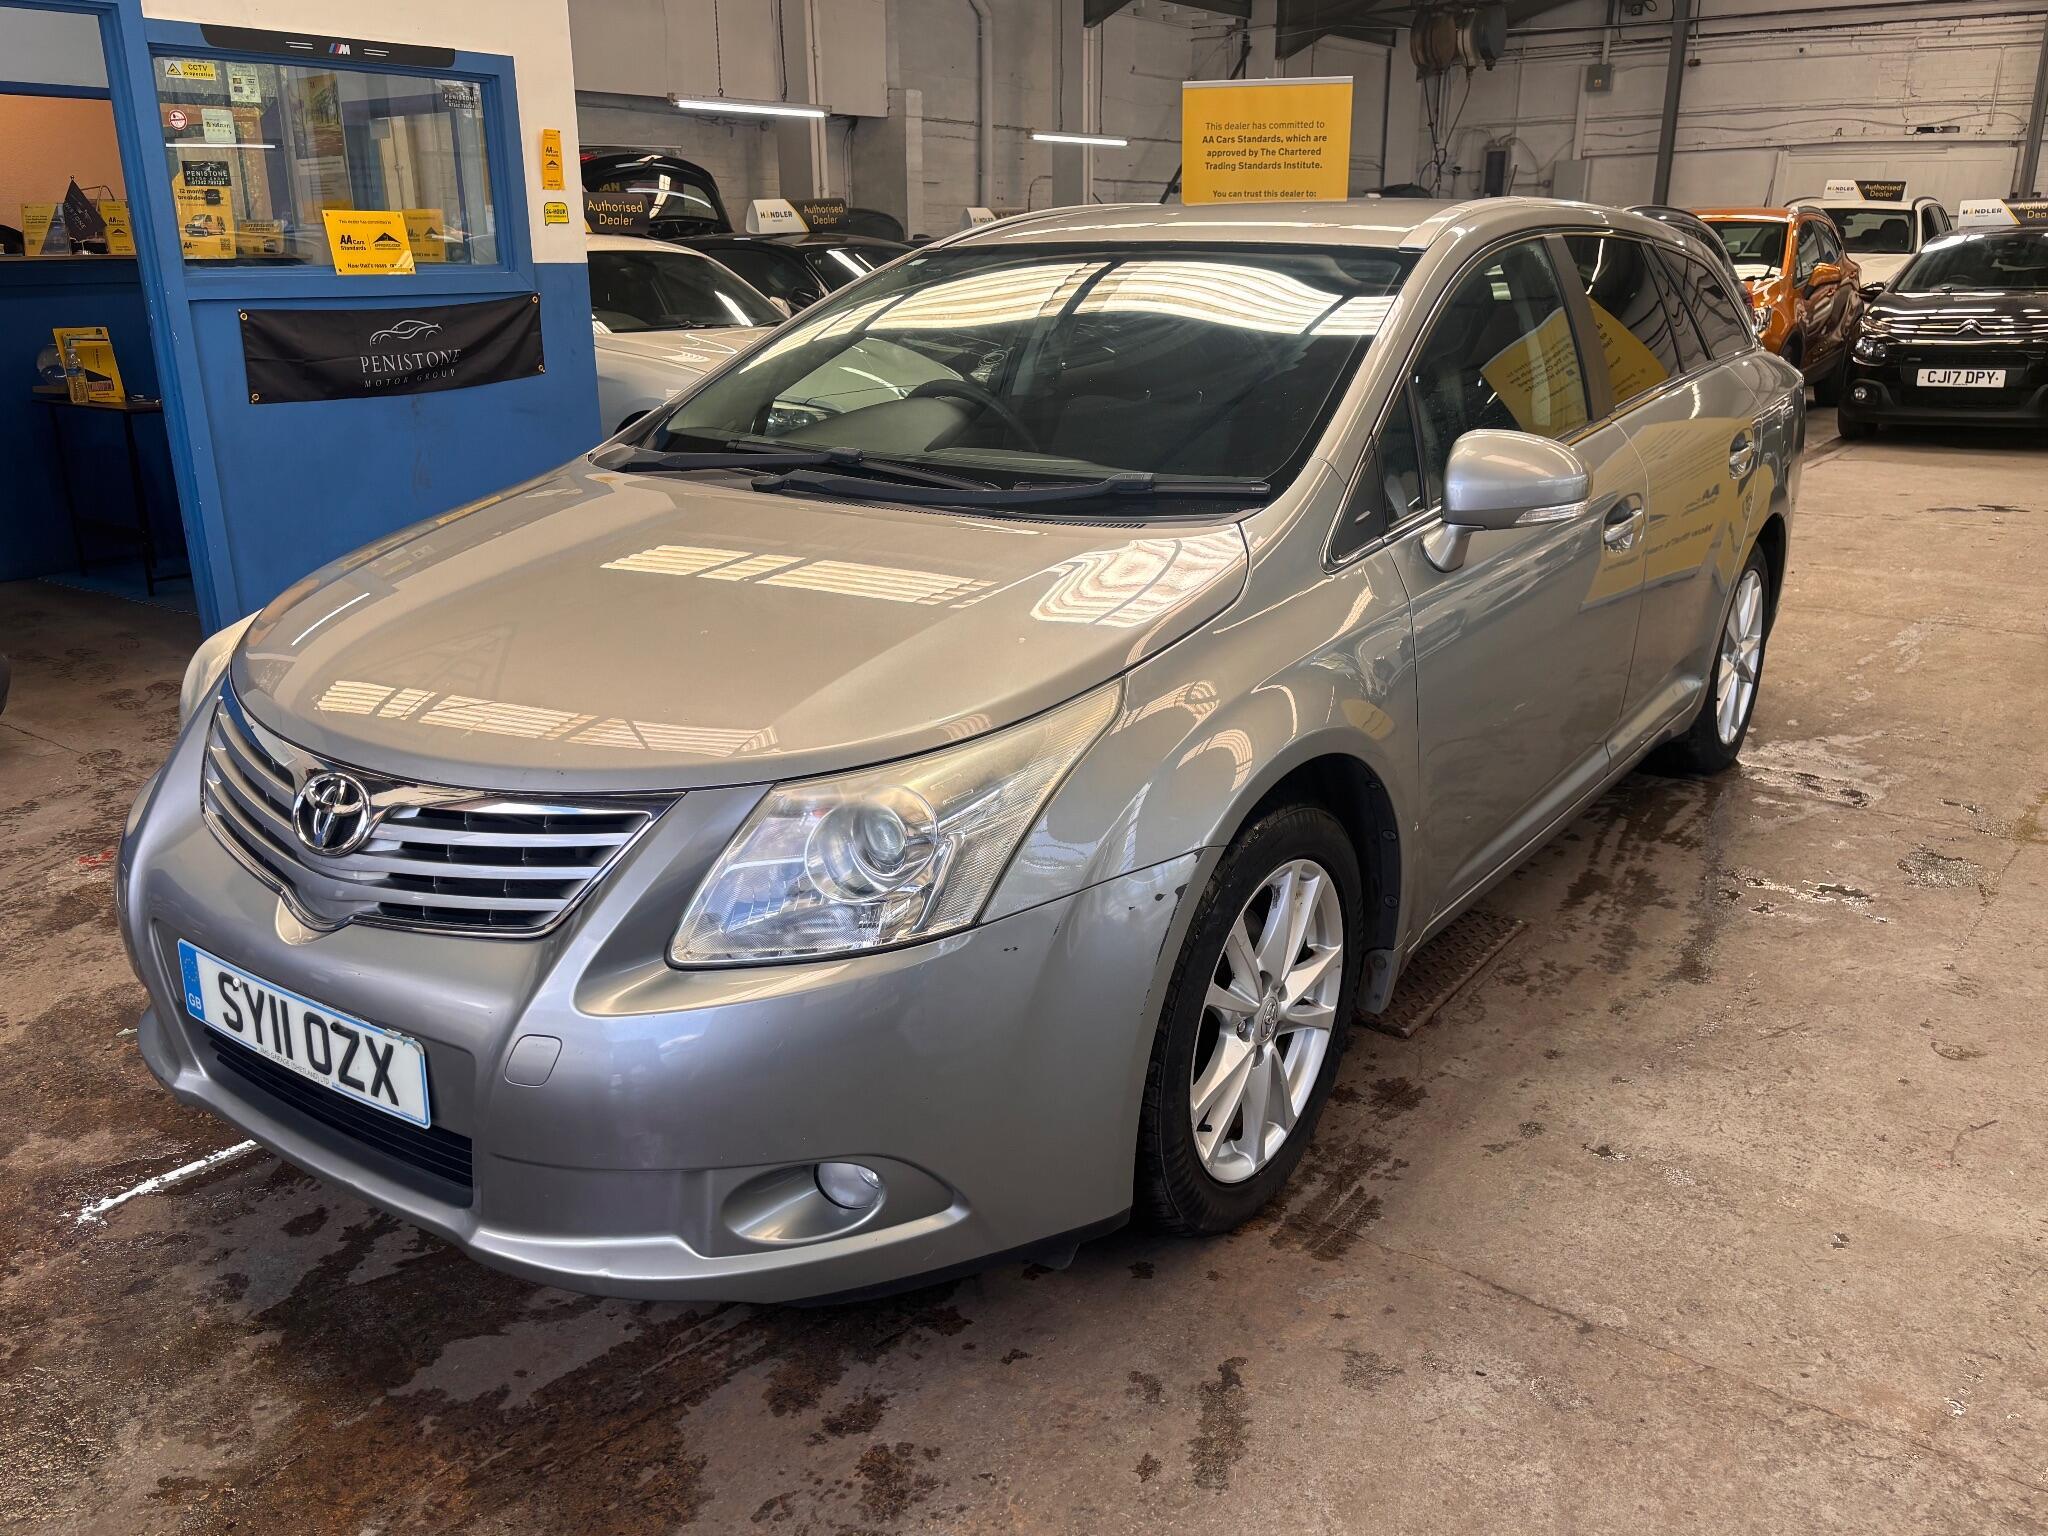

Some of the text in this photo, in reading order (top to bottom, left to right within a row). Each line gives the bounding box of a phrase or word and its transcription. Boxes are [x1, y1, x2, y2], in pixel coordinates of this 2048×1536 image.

[188, 63, 207, 71] CCTV
[1206, 121, 1325, 131] This dealer has committed to
[1202, 136, 1214, 144] AA
[1216, 135, 1235, 143] Cars
[1237, 135, 1284, 144] Standards,
[1285, 134, 1311, 142] which
[1207, 148, 1321, 159] approved by The Chartered
[1205, 161, 1323, 171] Trading Standards Institute.
[1865, 183, 1902, 191] Authorised
[1213, 190, 1227, 198] You
[1244, 190, 1262, 198] trust
[1264, 190, 1278, 198] this
[1280, 190, 1304, 198] dealer
[587, 200, 643, 213] Authorised
[803, 204, 844, 214] Authorised
[599, 213, 634, 226] Dealer
[812, 215, 838, 225] Dealer
[340, 234, 353, 244] AA
[183, 241, 192, 249] AA
[360, 349, 462, 373] PENISTONE
[364, 368, 455, 388] MOTOR GROUP
[1927, 370, 1996, 384] CJ17 DPY
[188, 992, 202, 1010] GB
[218, 971, 400, 1107] SY11 OZX
